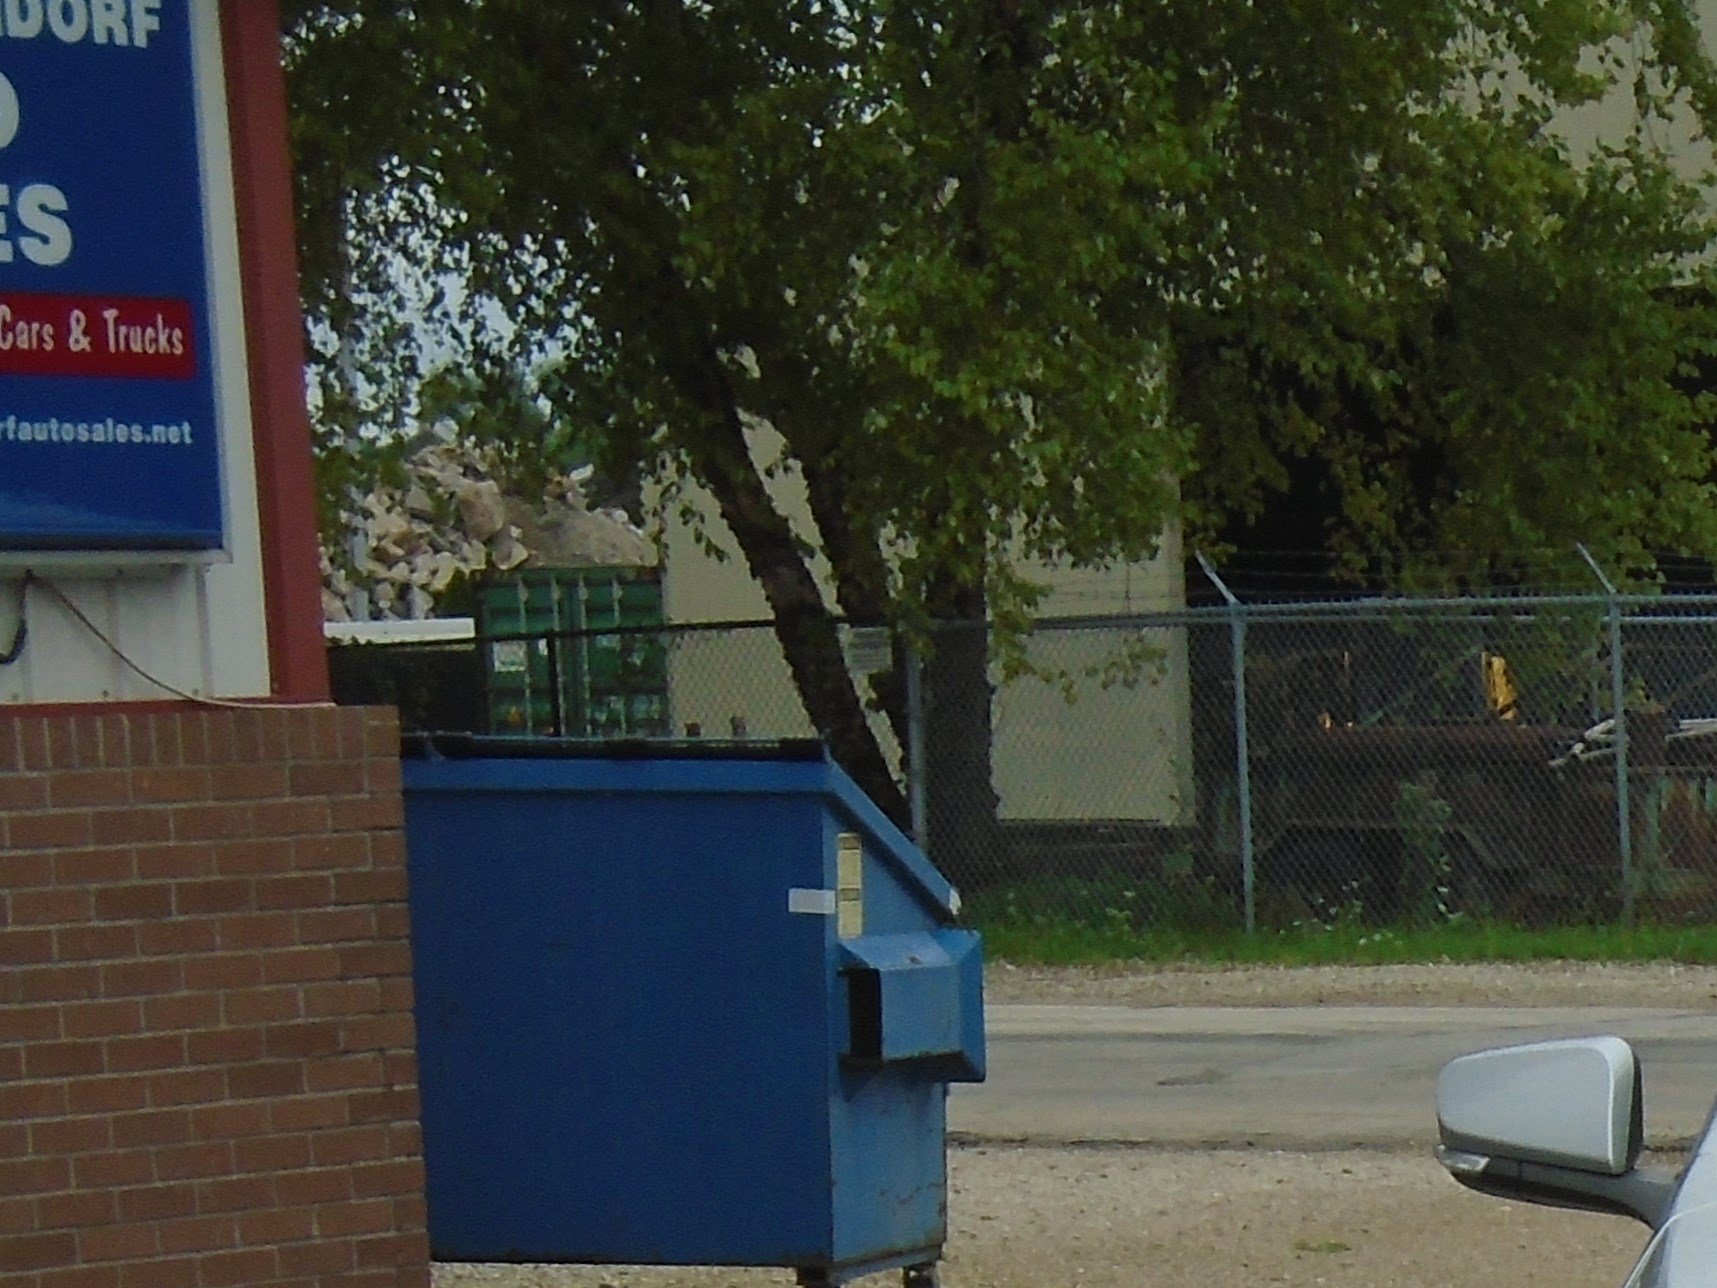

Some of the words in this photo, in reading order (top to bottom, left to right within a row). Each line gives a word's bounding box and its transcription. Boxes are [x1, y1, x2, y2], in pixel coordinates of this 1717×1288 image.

[0, 0, 161, 48] DORF
[0, 304, 54, 351] Cars
[69, 309, 91, 352] &
[103, 309, 183, 356] Trucks
